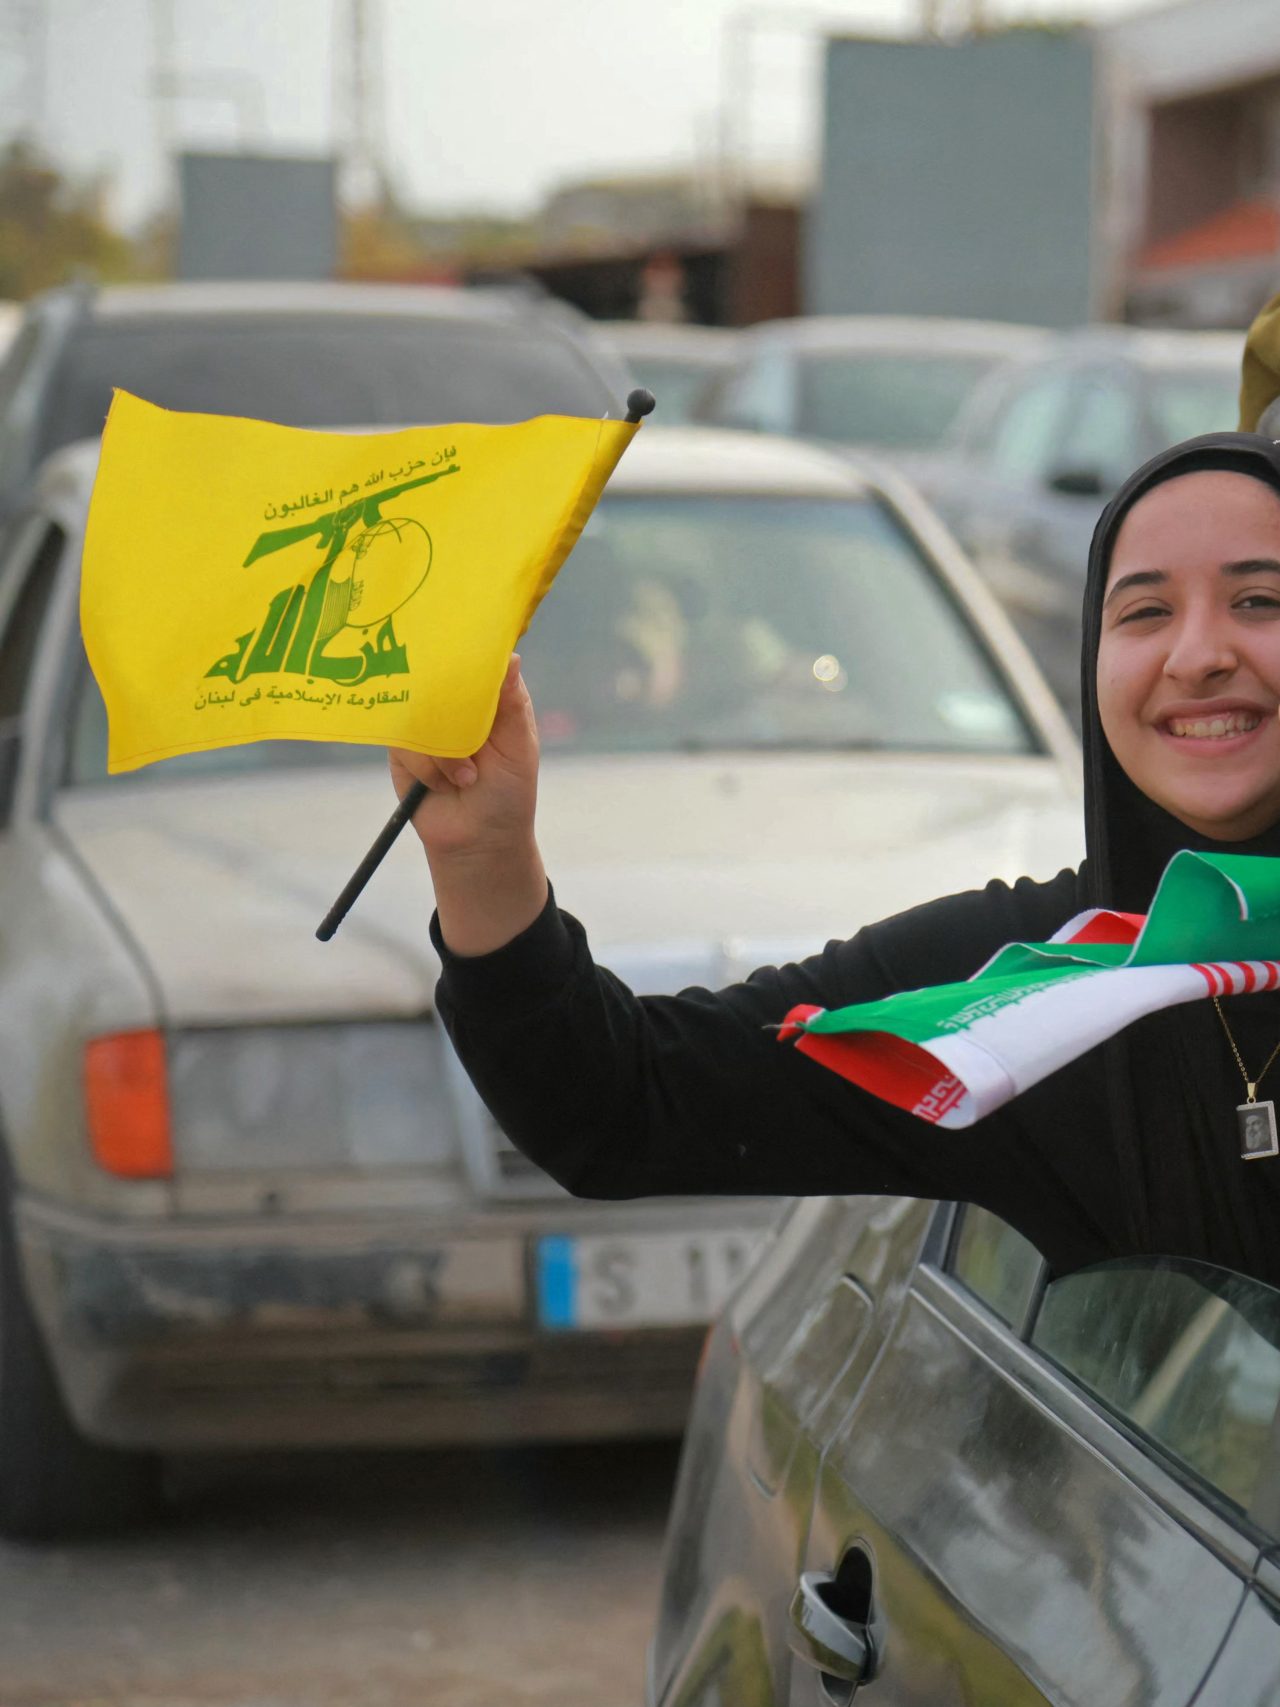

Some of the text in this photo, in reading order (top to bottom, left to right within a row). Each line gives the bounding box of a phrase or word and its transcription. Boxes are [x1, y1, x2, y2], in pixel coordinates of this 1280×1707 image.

[363, 470, 384, 488] الله
[389, 459, 426, 482] حزب
[264, 489, 333, 520] الغالبون
[338, 483, 359, 504] هم
[194, 689, 235, 711] لبنان
[266, 685, 341, 711] الإسلامية
[346, 689, 410, 710] المقاومة
[593, 1244, 637, 1315] S
